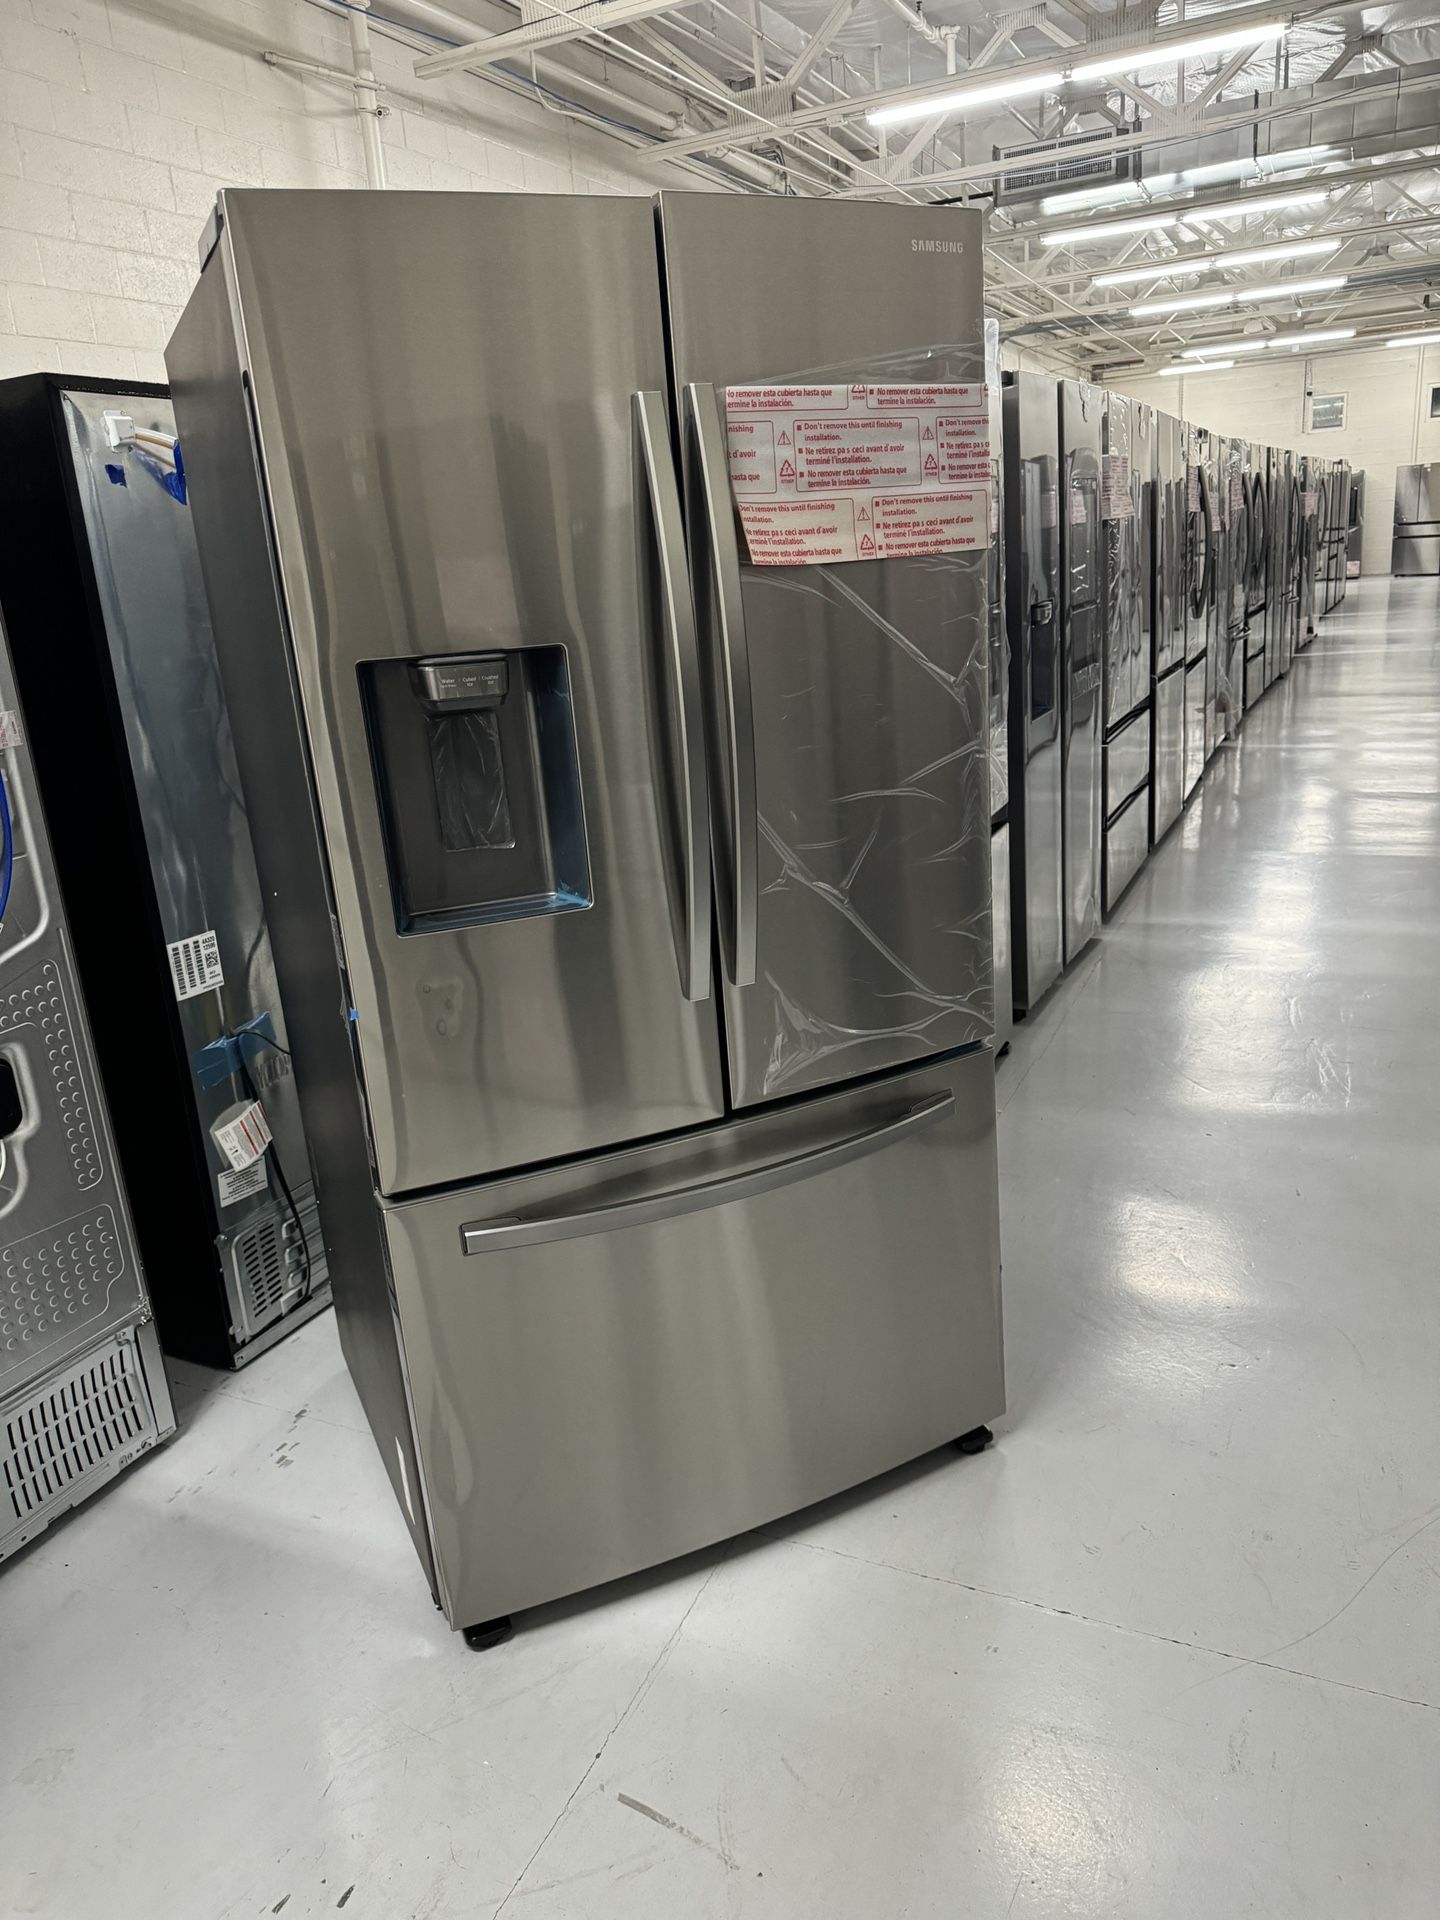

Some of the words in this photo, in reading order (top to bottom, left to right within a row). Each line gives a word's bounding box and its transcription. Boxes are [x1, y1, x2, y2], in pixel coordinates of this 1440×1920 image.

[911, 239, 964, 253] SAMSUNG
[821, 389, 832, 399] que
[876, 421, 902, 429] finishing
[806, 457, 830, 465] terminé
[896, 467, 907, 475] que
[748, 474, 760, 482] que
[838, 478, 871, 486] instalación.
[807, 502, 835, 511] finishing
[927, 518, 937, 526] ceci
[798, 527, 815, 535] avant
[831, 548, 842, 556] que
